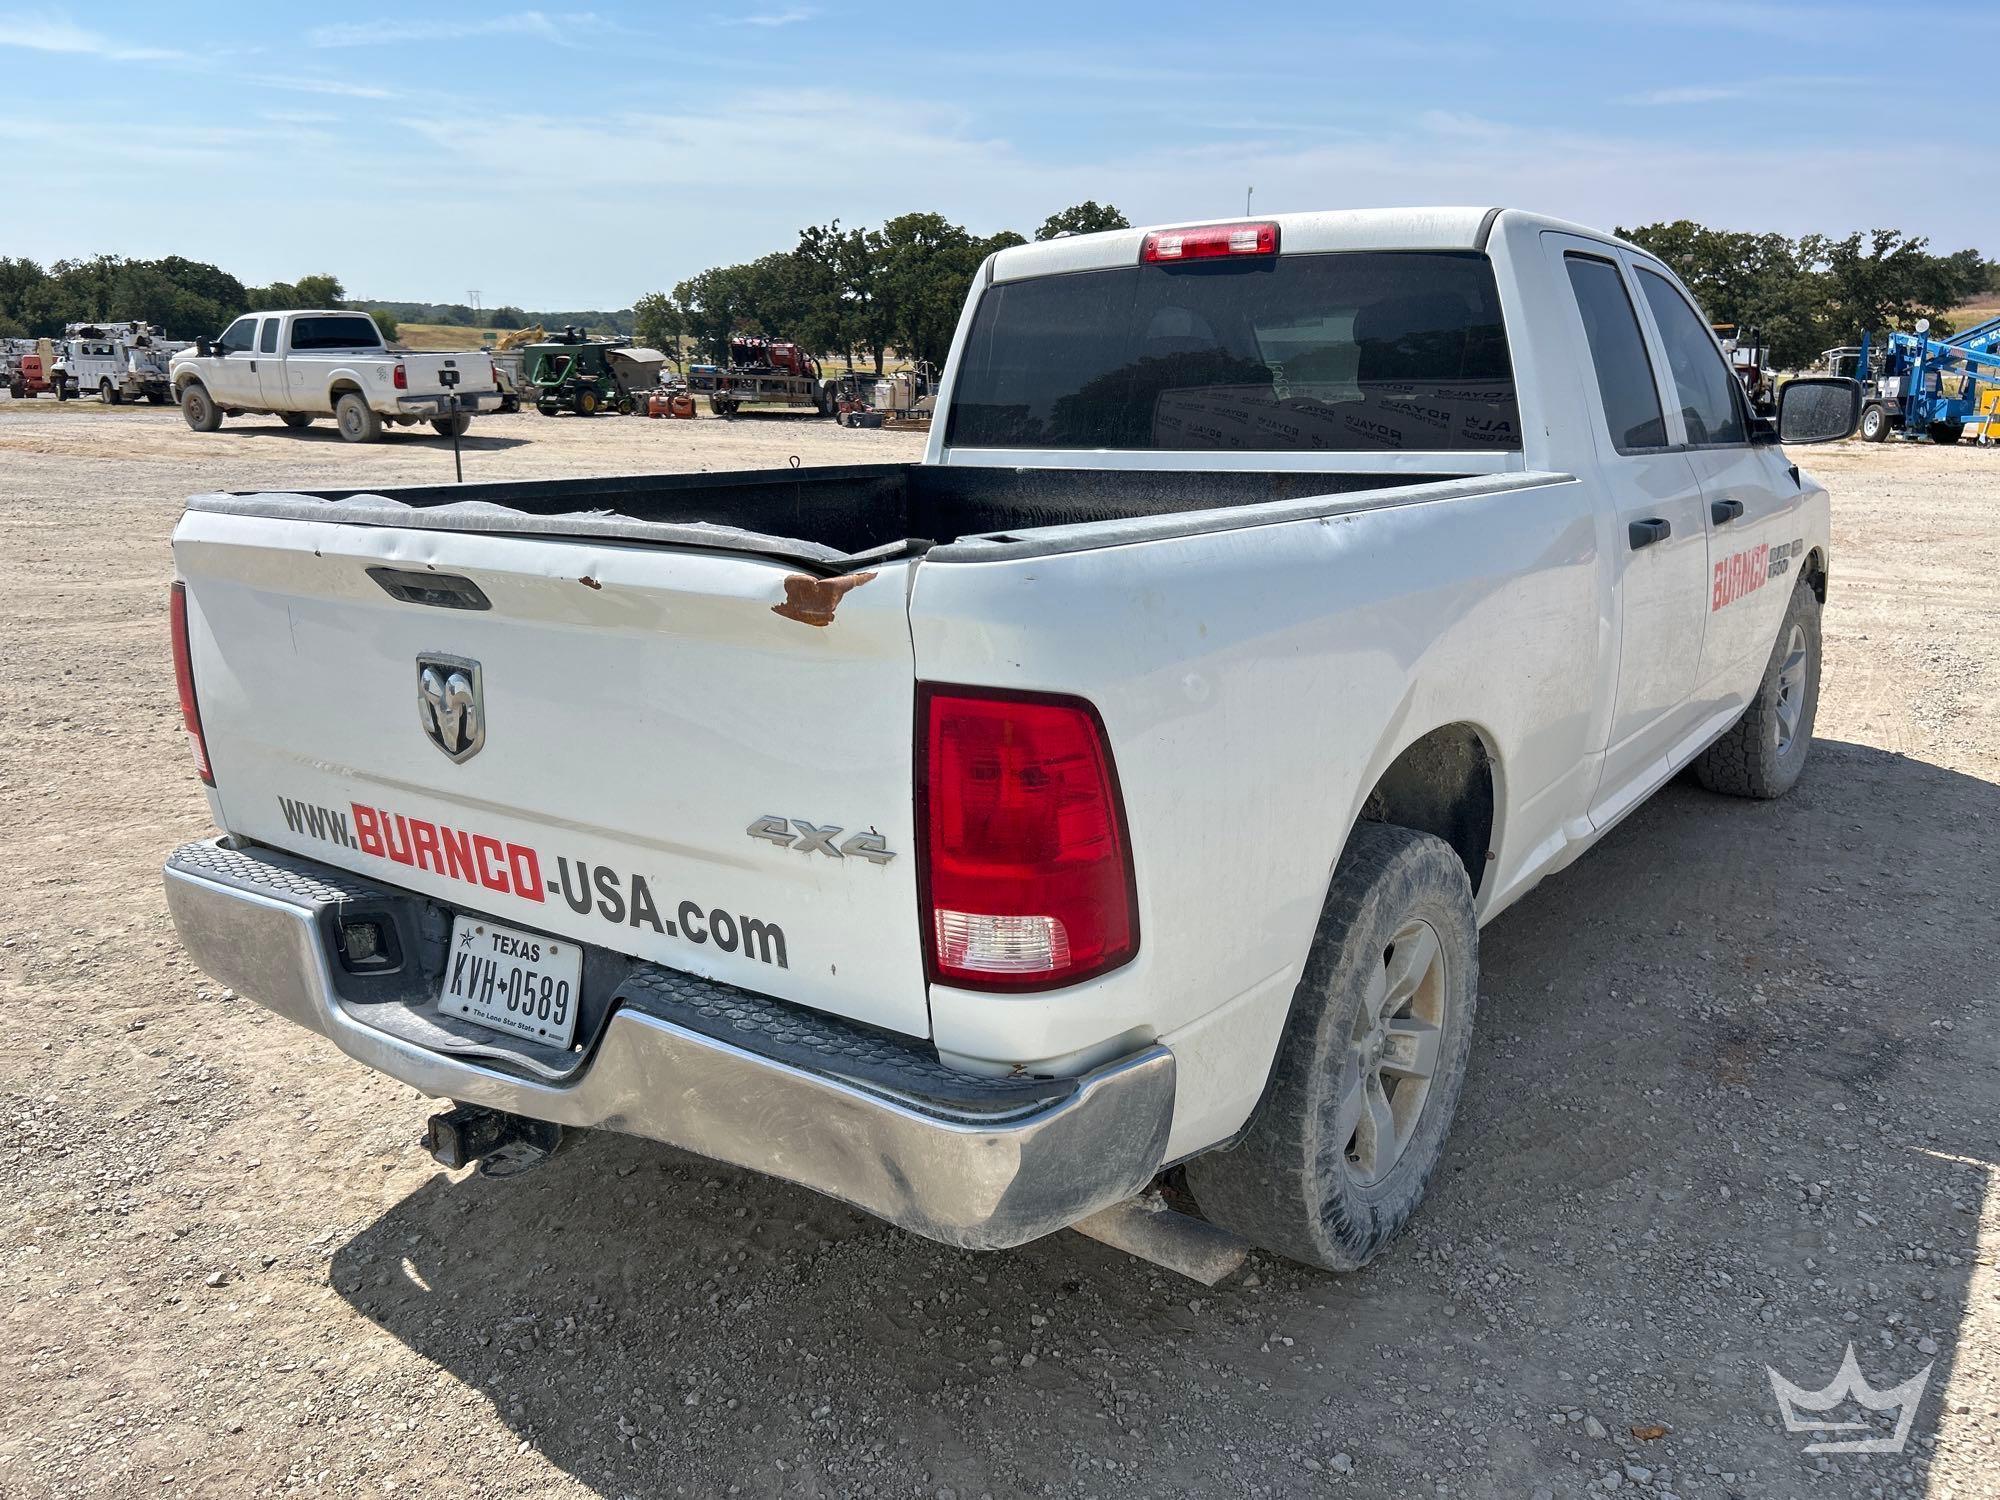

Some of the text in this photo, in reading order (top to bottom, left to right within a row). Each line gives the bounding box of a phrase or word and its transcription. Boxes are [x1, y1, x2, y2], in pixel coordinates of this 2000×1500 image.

[1712, 543, 1769, 612] BURNCO
[492, 933, 540, 962] TEXAS
[474, 1008, 486, 1018] The
[503, 1017, 517, 1028] Star
[518, 1022, 535, 1033] State
